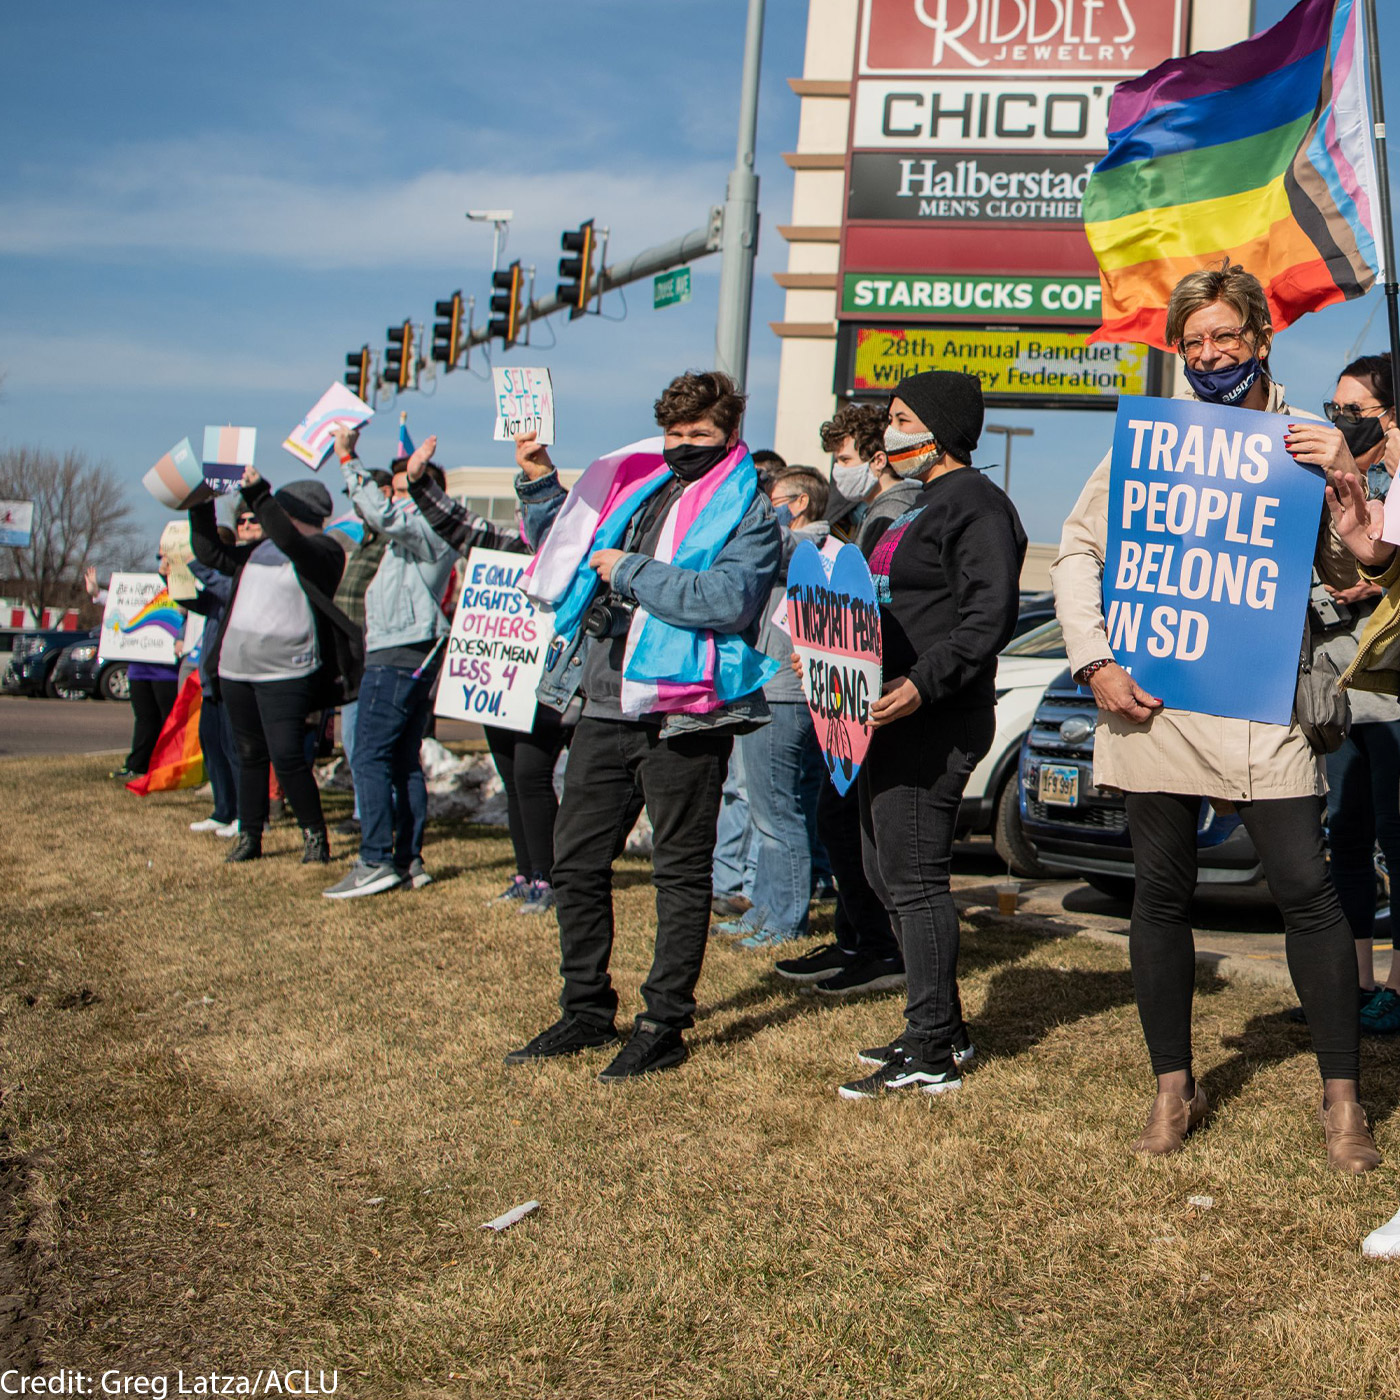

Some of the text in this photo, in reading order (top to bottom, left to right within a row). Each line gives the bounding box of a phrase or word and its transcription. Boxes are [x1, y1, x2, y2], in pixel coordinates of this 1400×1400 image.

[994, 45, 1135, 61] JEWELRY
[882, 86, 1113, 139] CHICO'
[918, 199, 980, 217] MEN'S
[854, 280, 1034, 309] STARBUCKS
[881, 338, 1123, 368] 28th Annual Banquet
[504, 369, 541, 393] SELF-
[1007, 367, 1127, 388] Federation
[500, 392, 550, 417] ESTEEM
[503, 418, 521, 438] NOT
[1128, 419, 1272, 484] TRANS
[1122, 480, 1280, 548] PEOPLE
[1115, 540, 1279, 611] BELONG
[462, 587, 522, 615] RIGHTS
[463, 613, 537, 641] OTHERS
[1107, 601, 1209, 662] IN SD
[500, 645, 540, 665] MEAN
[449, 658, 519, 691] LESS 4
[463, 684, 506, 717] YOU.
[809, 658, 870, 737] BELONG
